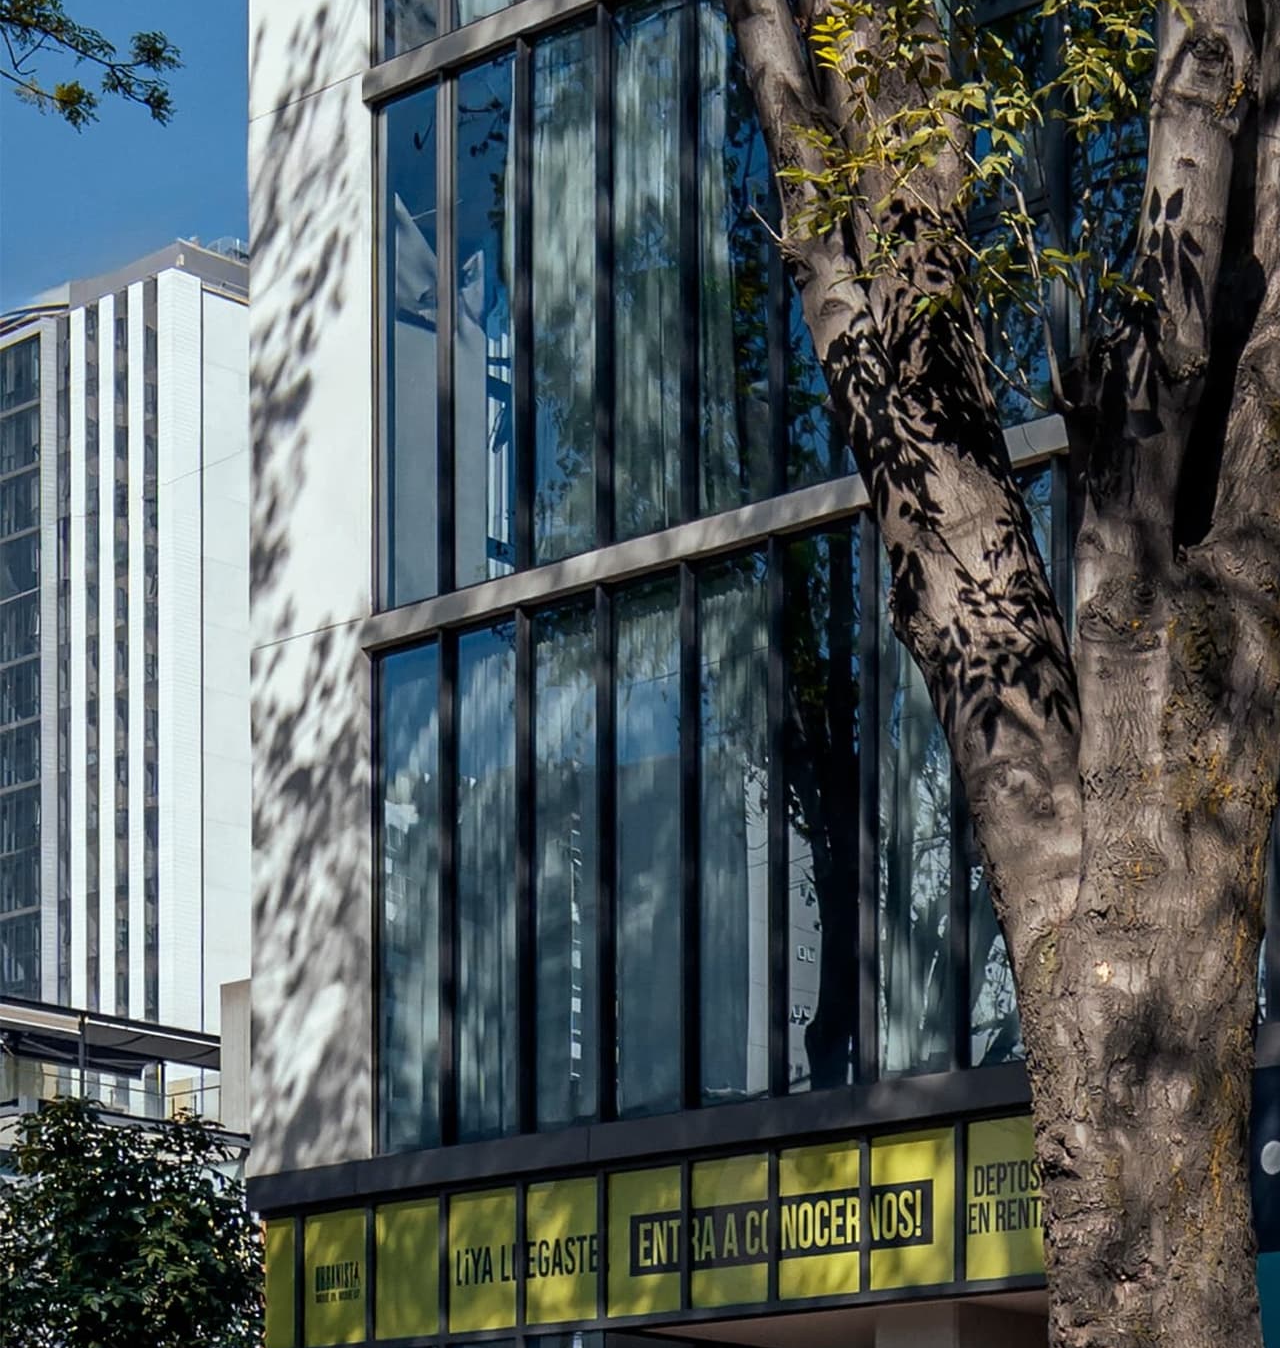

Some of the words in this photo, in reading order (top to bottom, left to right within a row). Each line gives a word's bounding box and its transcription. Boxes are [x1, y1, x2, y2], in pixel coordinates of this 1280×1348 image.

[974, 1160, 1041, 1198] DEPTOS
[968, 1202, 990, 1235] EN
[996, 1196, 1043, 1232] RENT
[639, 1215, 716, 1267] ENTRA
[723, 1212, 739, 1259] A
